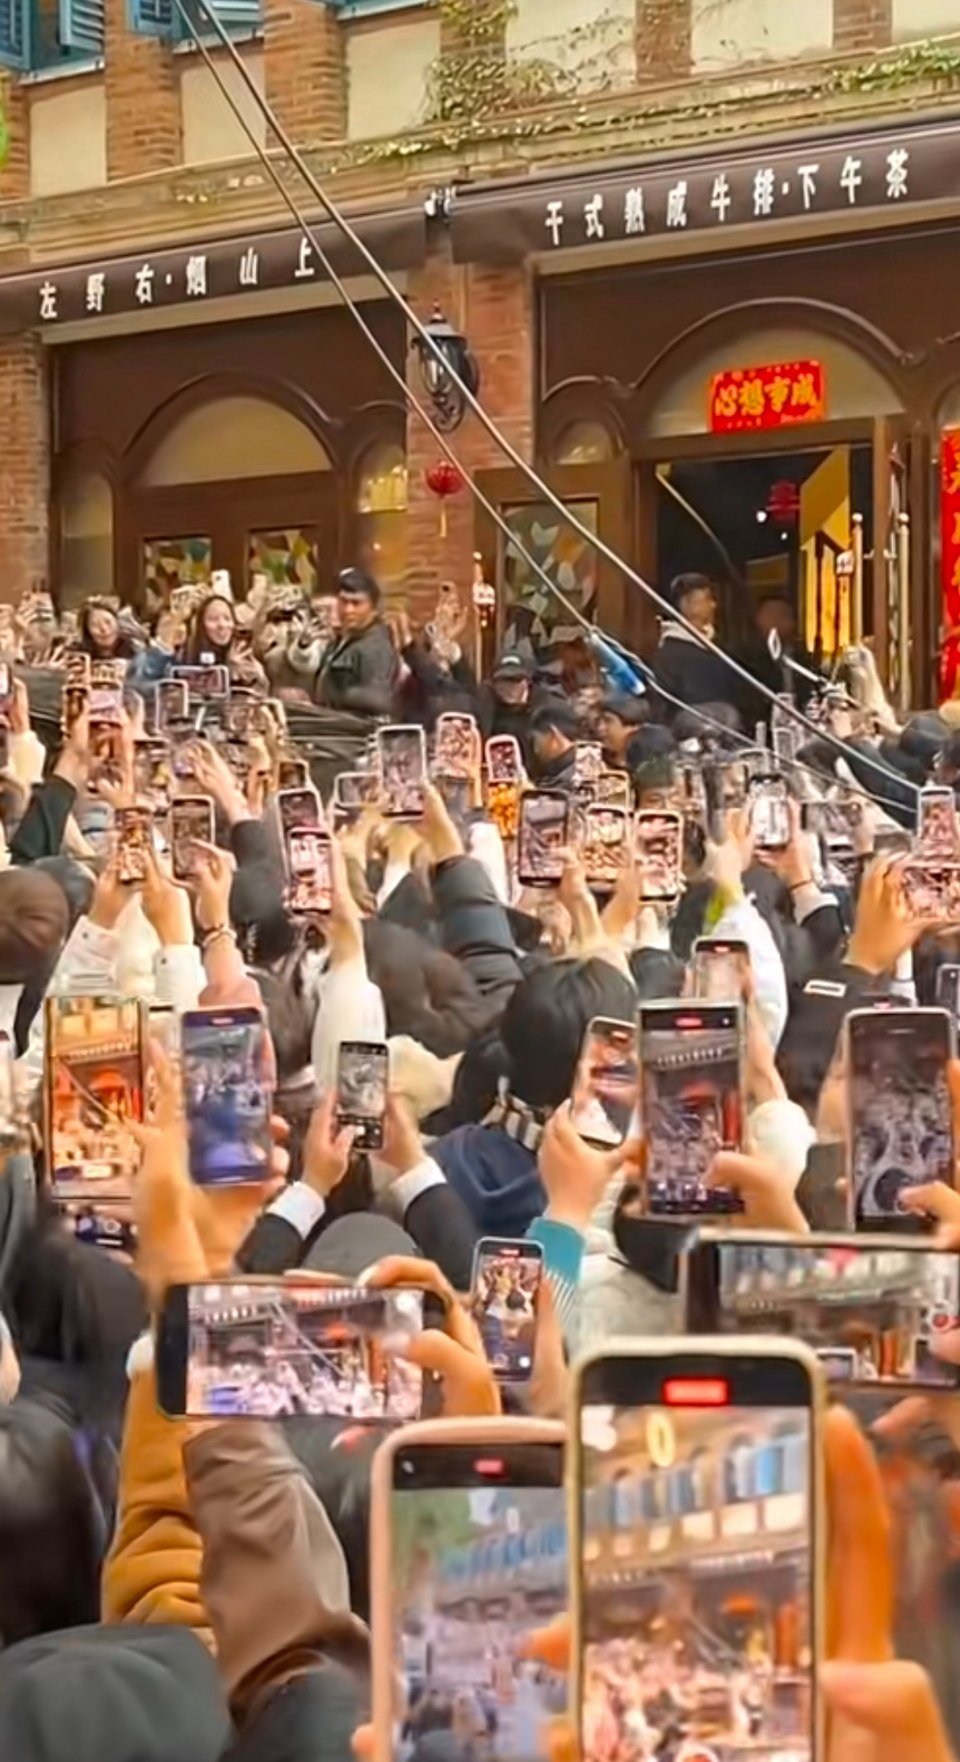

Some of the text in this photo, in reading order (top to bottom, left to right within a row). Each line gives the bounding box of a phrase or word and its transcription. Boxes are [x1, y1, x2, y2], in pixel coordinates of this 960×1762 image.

[545, 148, 909, 246] 干式熟成牛排·下午茶
[714, 372, 817, 417] 心想事成
